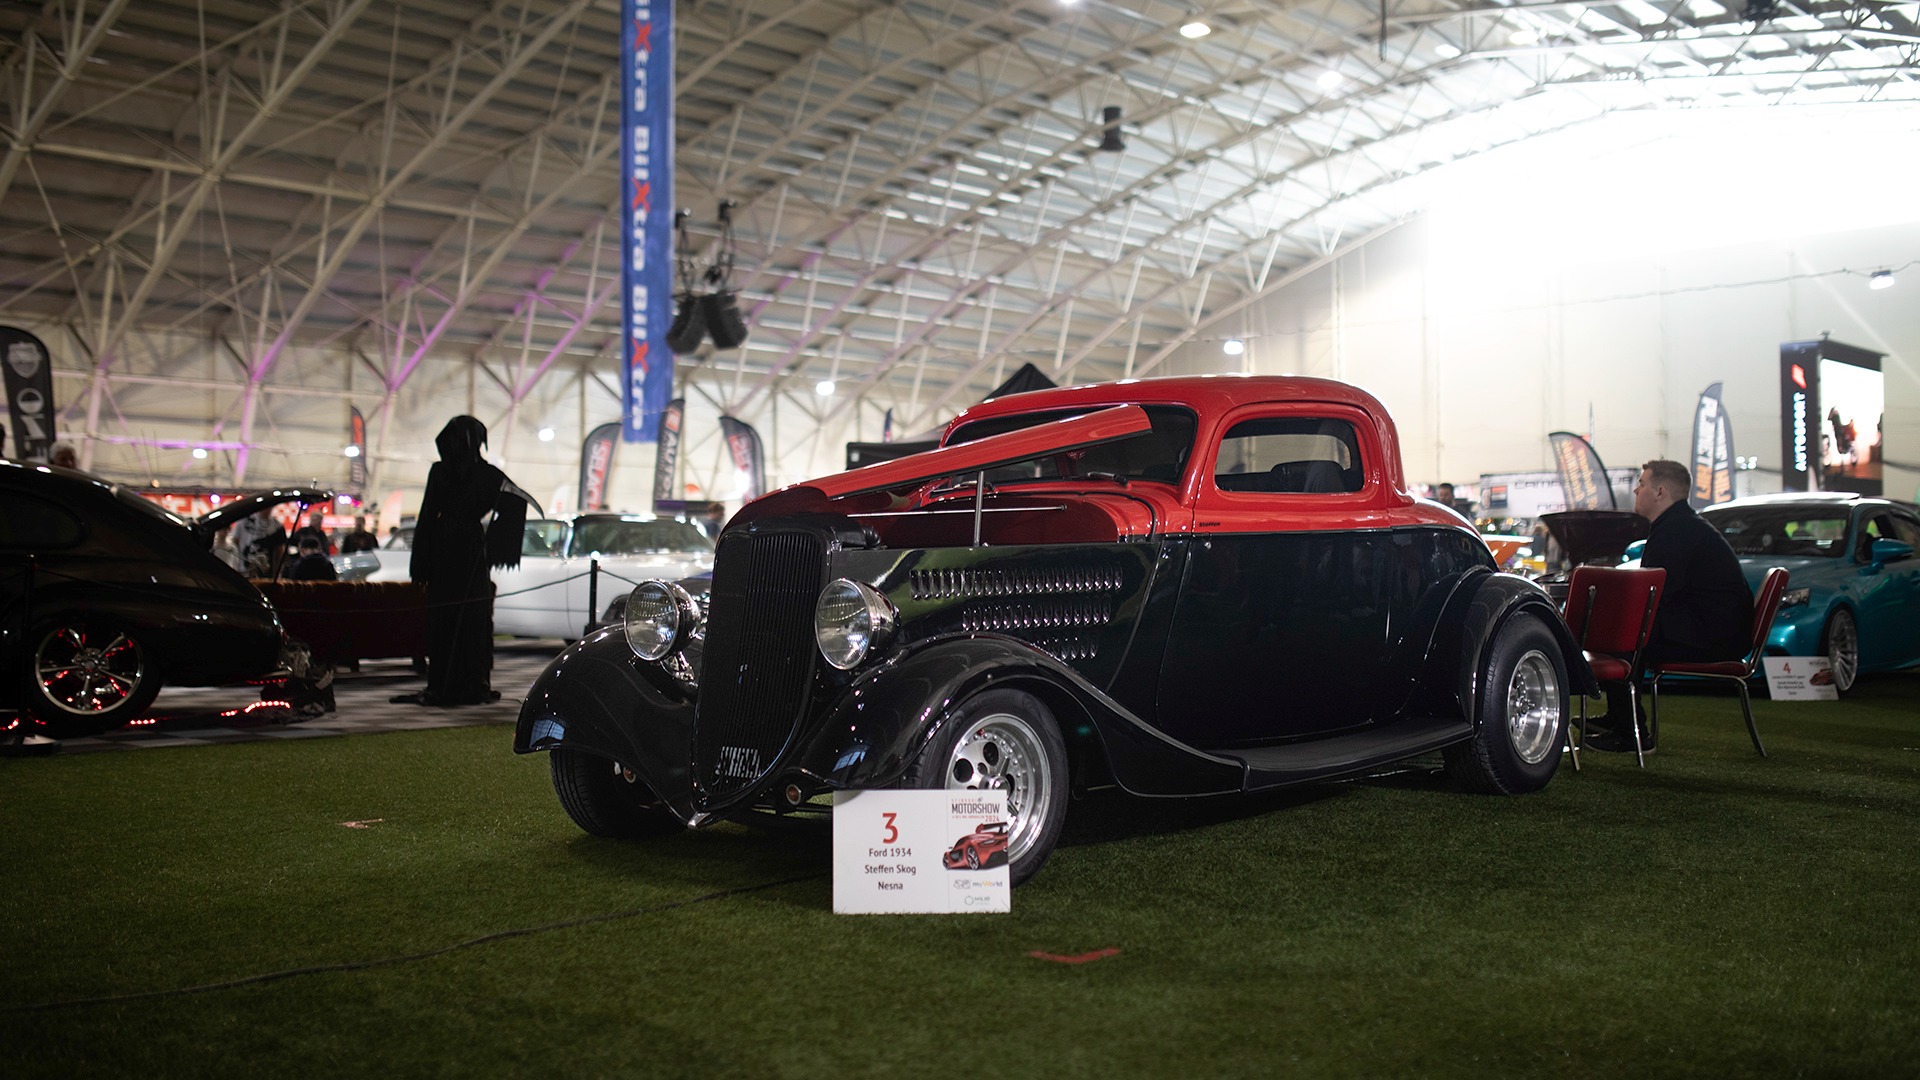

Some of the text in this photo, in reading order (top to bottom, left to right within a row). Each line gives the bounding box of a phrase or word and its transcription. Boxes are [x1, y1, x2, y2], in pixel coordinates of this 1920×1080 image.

[631, 126, 651, 271] BilXtra
[630, 284, 649, 430] BilXtra
[1782, 662, 1791, 674] 4
[952, 803, 1000, 814] MOTORSHOW
[882, 812, 899, 844] 3
[869, 848, 912, 857] Ford 1934
[864, 865, 917, 876] Steffen Skog
[877, 882, 904, 890] Nesna
